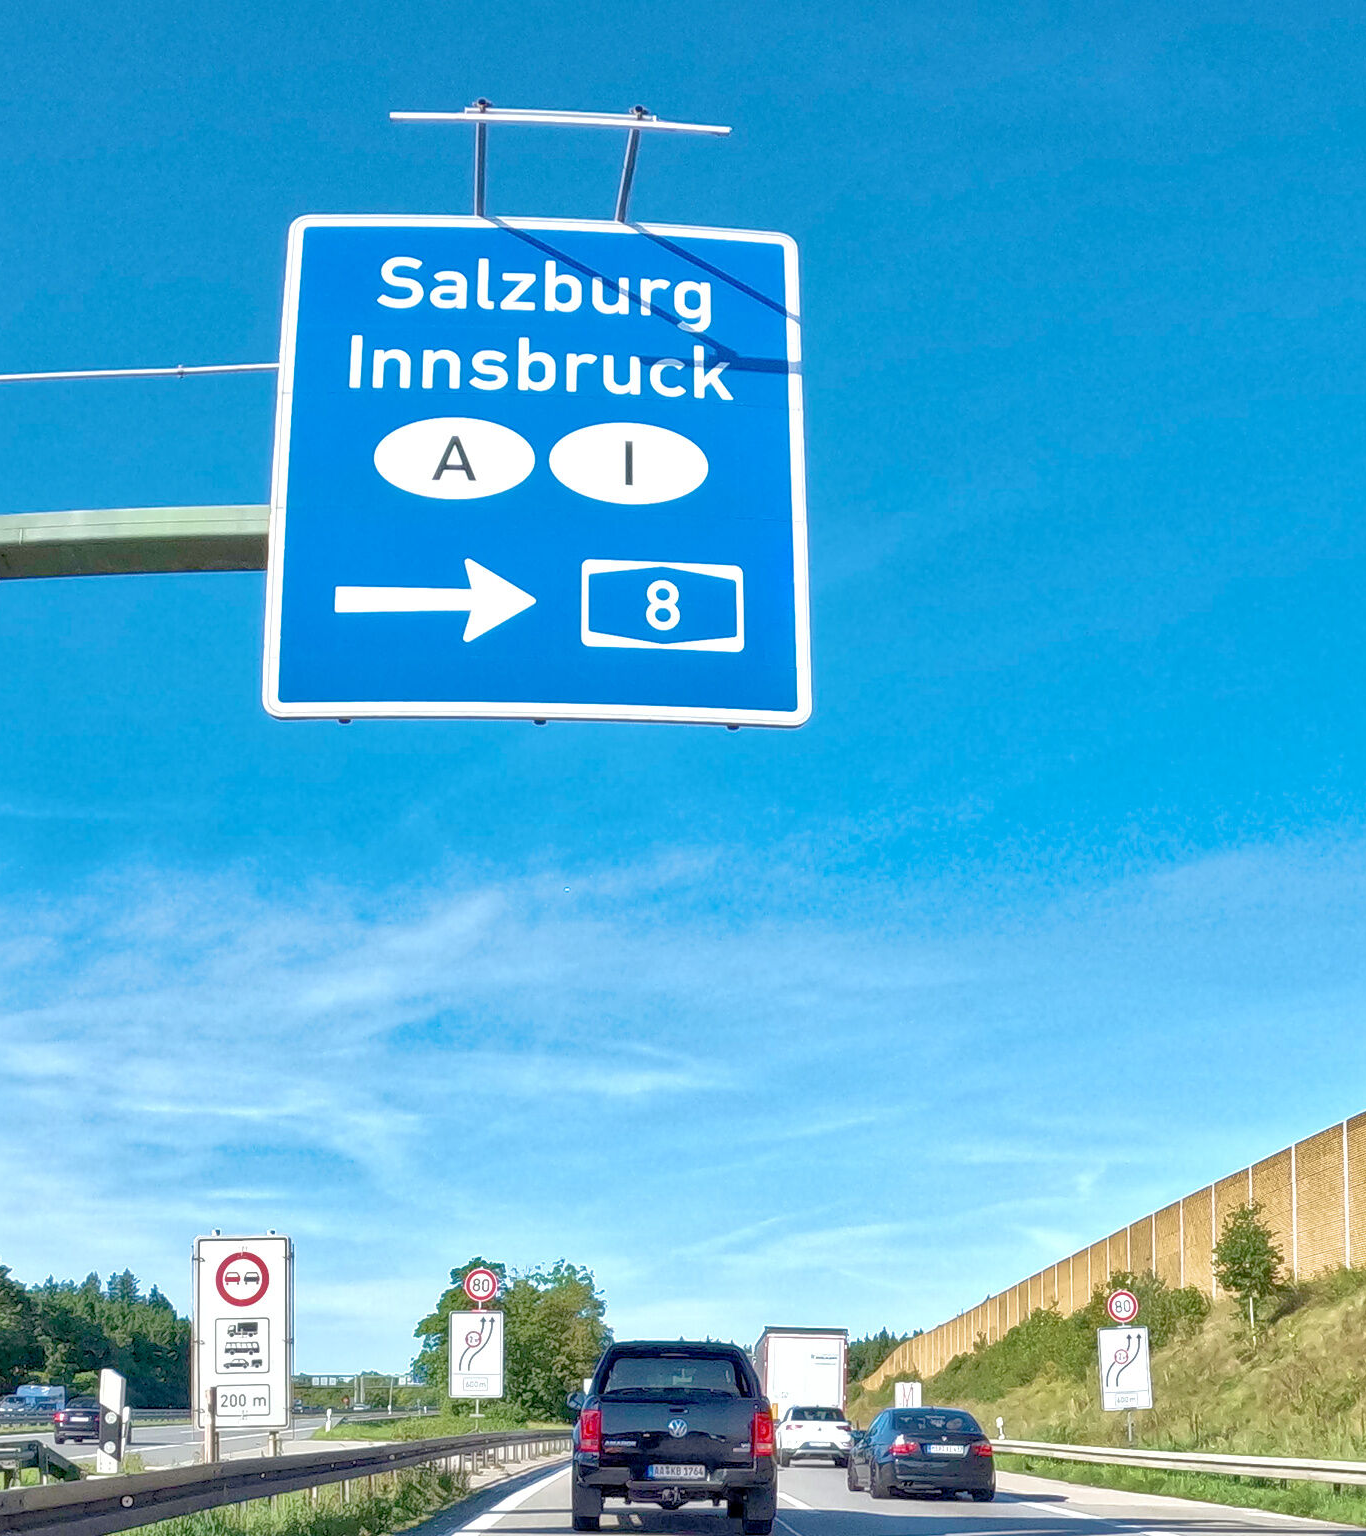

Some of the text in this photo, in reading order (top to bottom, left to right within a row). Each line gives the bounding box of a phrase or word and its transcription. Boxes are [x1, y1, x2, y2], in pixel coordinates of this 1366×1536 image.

[376, 256, 713, 333] Salzburg
[349, 334, 734, 401] Innsbruck
[431, 435, 634, 486] A I
[645, 580, 680, 631] 8
[472, 1278, 490, 1293] 80
[1115, 1299, 1131, 1313] 80
[220, 1394, 267, 1407] 200 m
